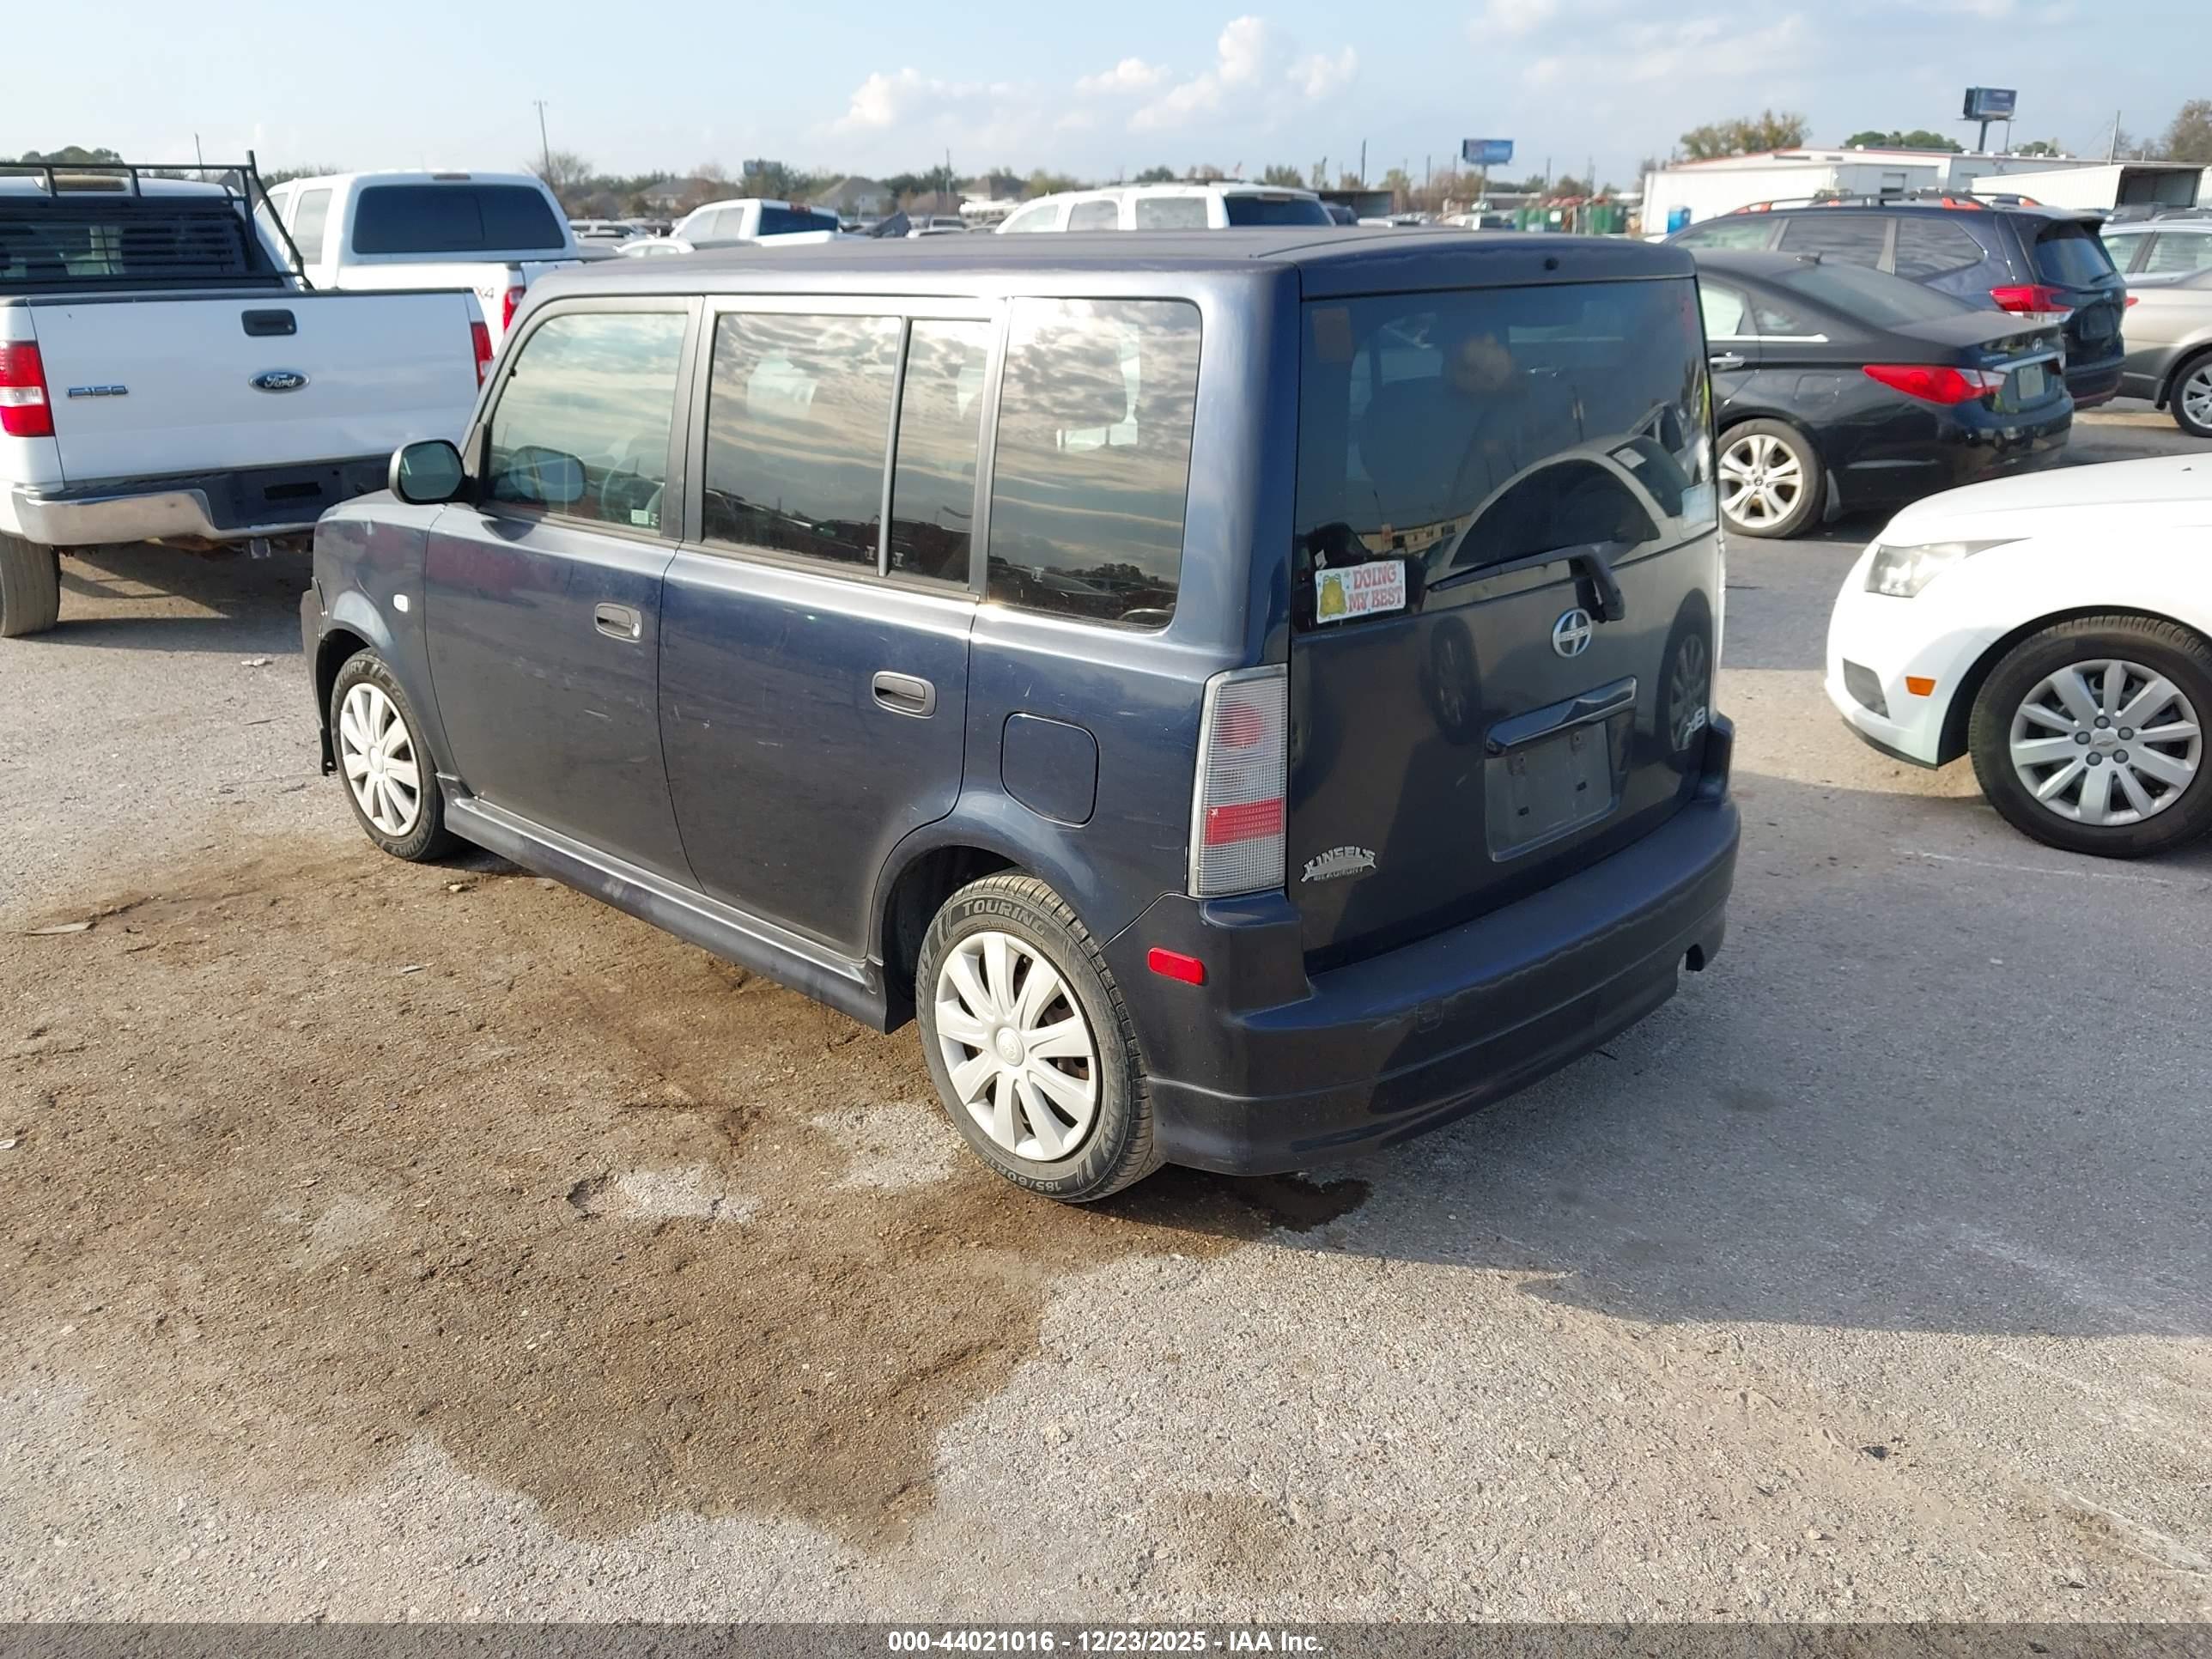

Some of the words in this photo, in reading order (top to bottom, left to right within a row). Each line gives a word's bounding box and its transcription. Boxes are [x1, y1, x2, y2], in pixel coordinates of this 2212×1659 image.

[264, 375, 296, 388] Ford
[1352, 563, 1396, 589] DOING
[1347, 591, 1369, 612] MY
[1371, 585, 1404, 608] BEST
[1304, 845, 1376, 874] KINSEL'S
[963, 899, 1045, 936] TOURING
